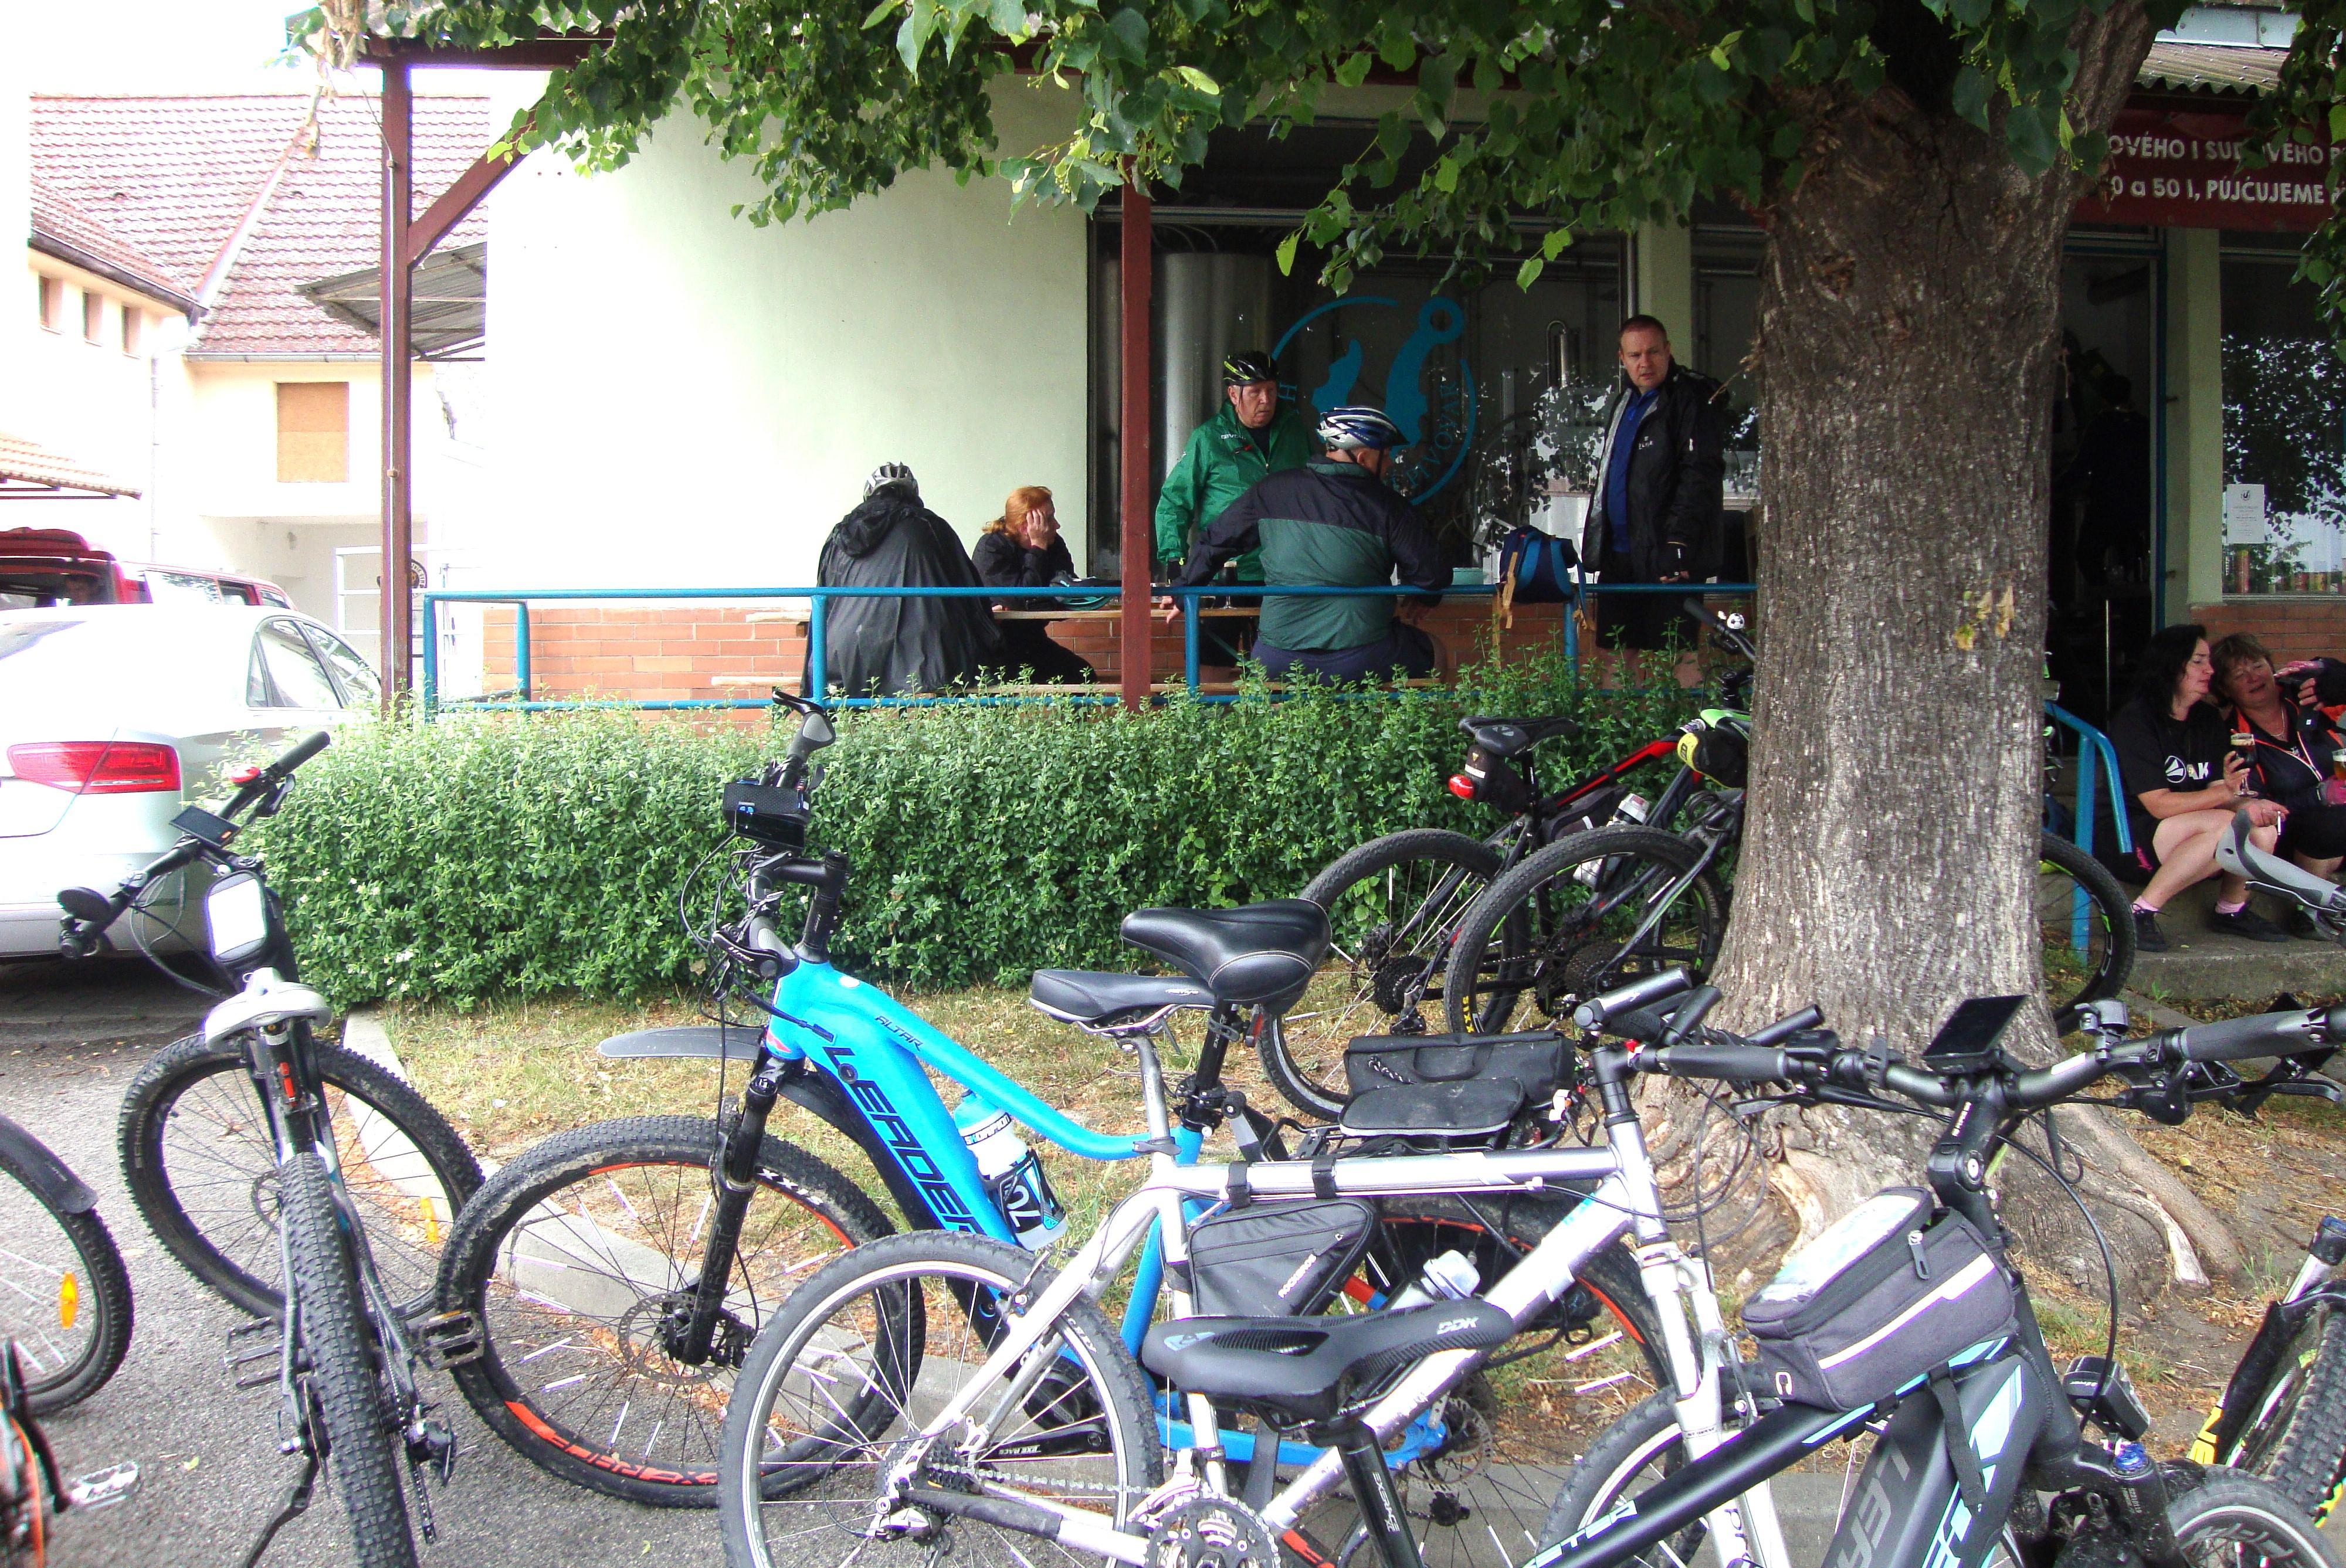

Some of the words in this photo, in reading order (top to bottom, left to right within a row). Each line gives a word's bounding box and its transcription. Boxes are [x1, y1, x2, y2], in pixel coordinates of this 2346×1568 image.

[2192, 140, 2198, 159] I
[2131, 180, 2145, 196] a
[2152, 178, 2179, 198] 50
[874, 1015, 924, 1051] ALTAR
[822, 1046, 984, 1234] LEADER
